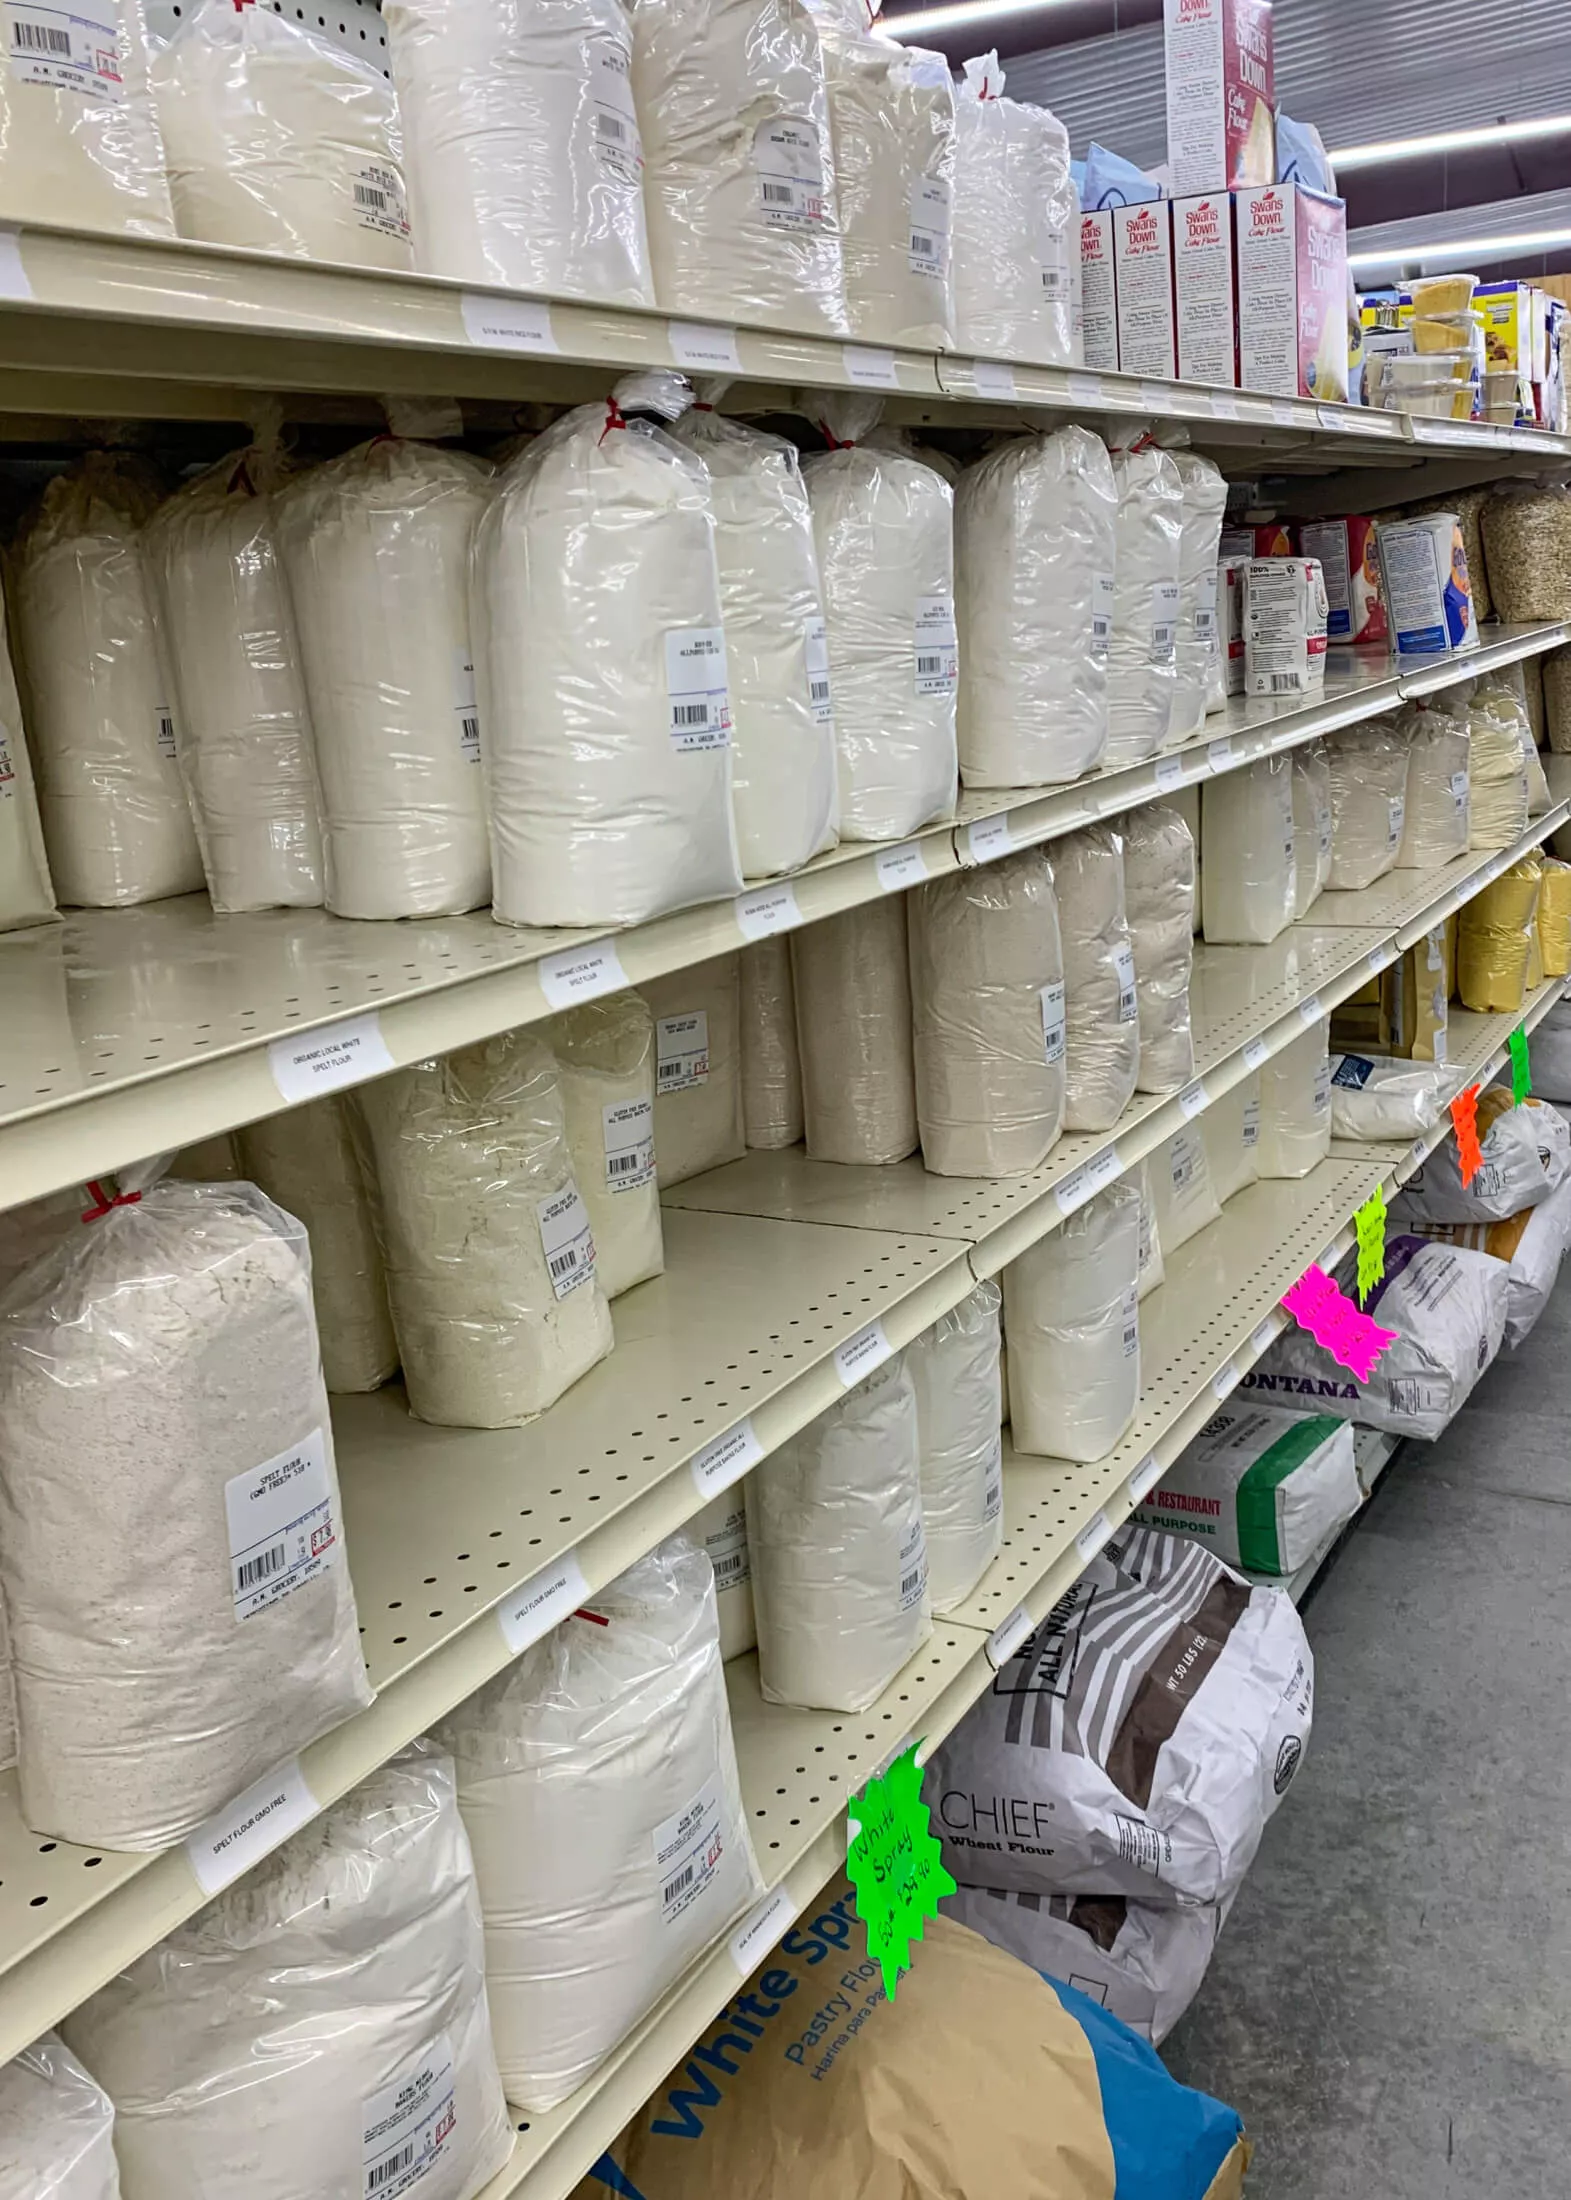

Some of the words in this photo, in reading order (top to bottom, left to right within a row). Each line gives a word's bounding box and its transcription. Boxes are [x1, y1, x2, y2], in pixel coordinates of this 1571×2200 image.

[1186, 210, 1218, 224] Swans
[1250, 199, 1284, 214] Swans
[1081, 226, 1101, 240] ans
[1126, 218, 1158, 233] Swans
[293, 1050, 322, 1065] ORGANIC
[322, 1044, 341, 1057] LOCAL
[312, 1060, 332, 1073] SPELT
[331, 1054, 353, 1067] FLOUR
[1240, 1373, 1361, 1400] ONTANA
[260, 1470, 281, 1485] SPELT
[1158, 1490, 1222, 1517] RESTAURANT
[1152, 1516, 1217, 1535] PURPOSE
[514, 1605, 529, 1621] SPELT
[528, 1594, 545, 1611] FLOUR
[543, 1587, 556, 1599] GMO
[554, 1577, 567, 1590] FREE
[1047, 1582, 1084, 1638] NATURAL
[1038, 1646, 1063, 1684] ALL
[1166, 1676, 1180, 1692] WT
[1175, 1664, 1188, 1680] 50
[1182, 1647, 1198, 1668] LBS
[213, 1833, 234, 1855] SPELT
[233, 1818, 256, 1839] FLOUR
[254, 1806, 271, 1822] GMO
[270, 1793, 287, 1811] FREE
[940, 1791, 1049, 1839] CHIEF
[853, 1807, 895, 1863] White
[949, 1835, 1003, 1852] Wheat
[1007, 1842, 1055, 1857] Flour
[872, 1823, 914, 1884] Spray
[652, 1969, 799, 2139] White
[782, 1891, 859, 1966] Spr
[784, 1991, 853, 2066] Pastry
[841, 1957, 883, 1993] Flou
[810, 2031, 849, 2081] Harina
[846, 2005, 873, 2037] para
